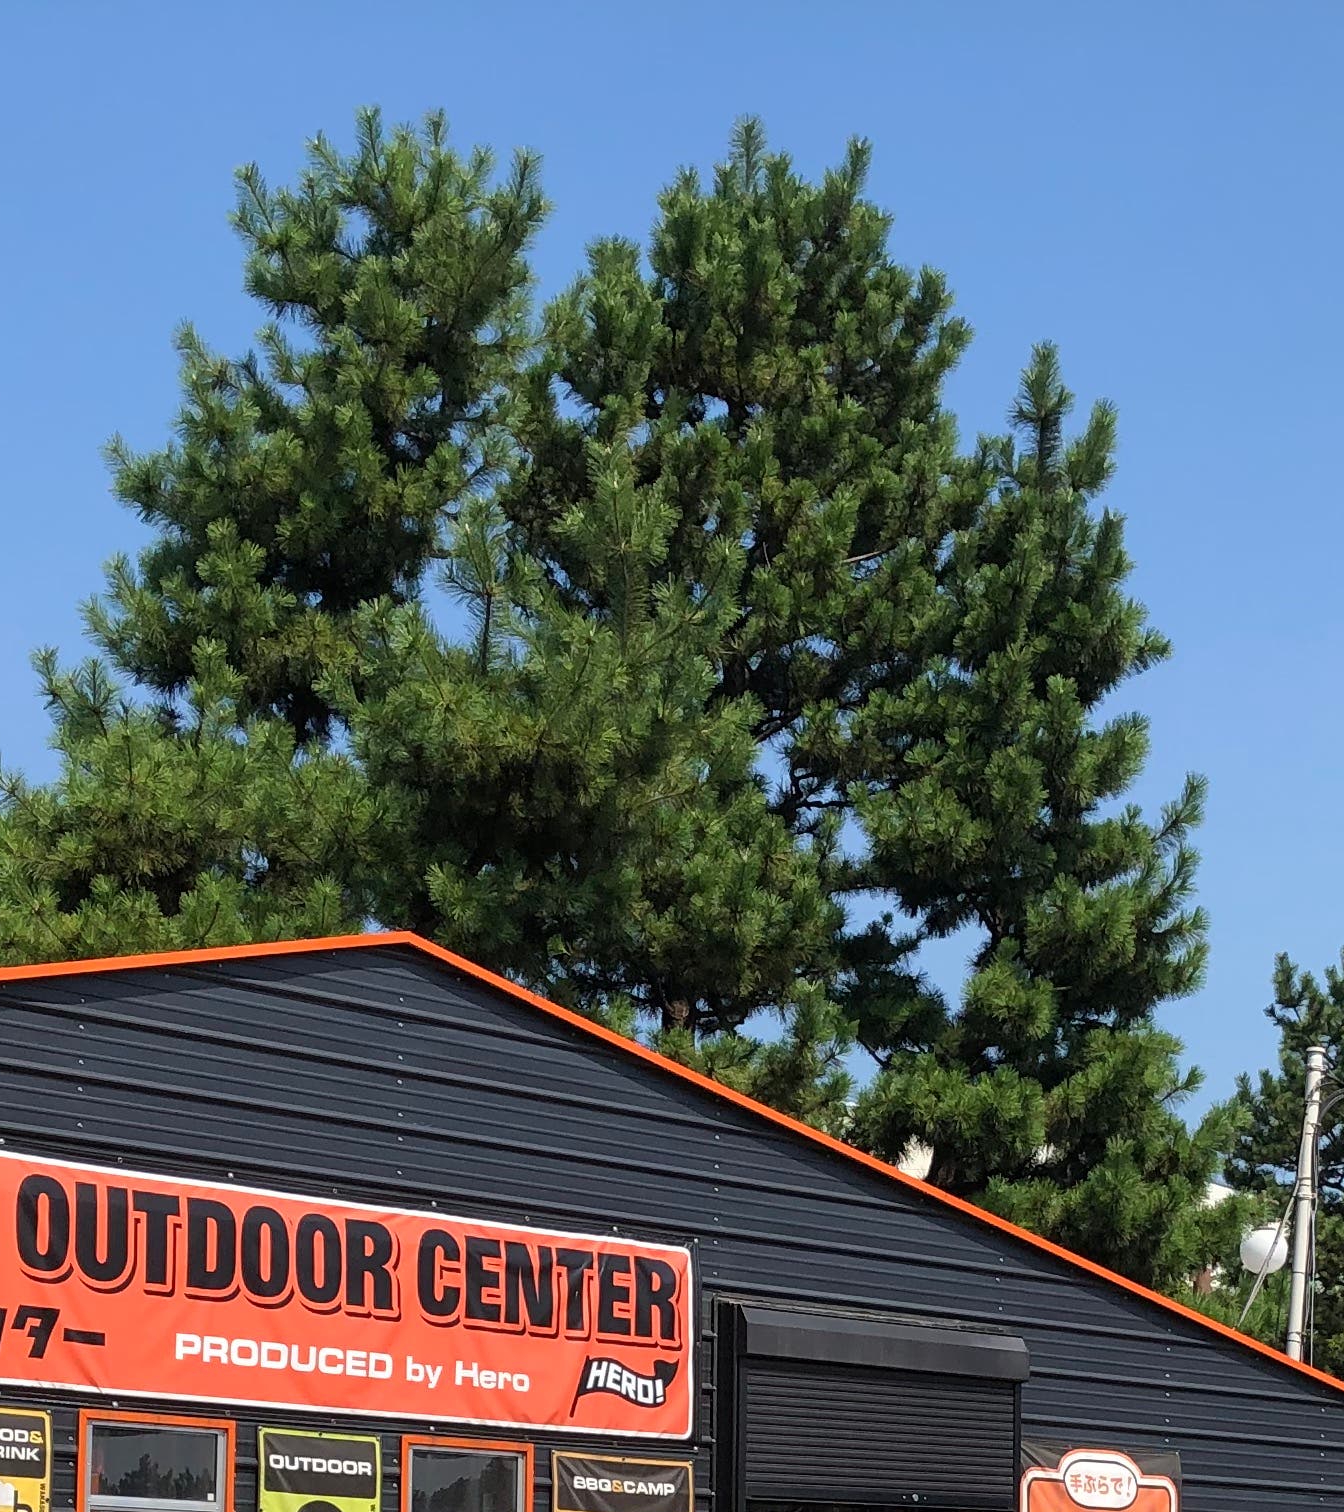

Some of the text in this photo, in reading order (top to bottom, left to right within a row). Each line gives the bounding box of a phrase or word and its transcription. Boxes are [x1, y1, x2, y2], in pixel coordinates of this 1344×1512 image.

[16, 1173, 401, 1320] OUTDOOR
[417, 1228, 682, 1348] CENTER
[174, 1332, 530, 1393] PRODUCED by Hero
[586, 1360, 665, 1405] HERO!
[268, 1453, 373, 1476] OUTDOOR
[572, 1475, 676, 1497] BBQ&CAMP
